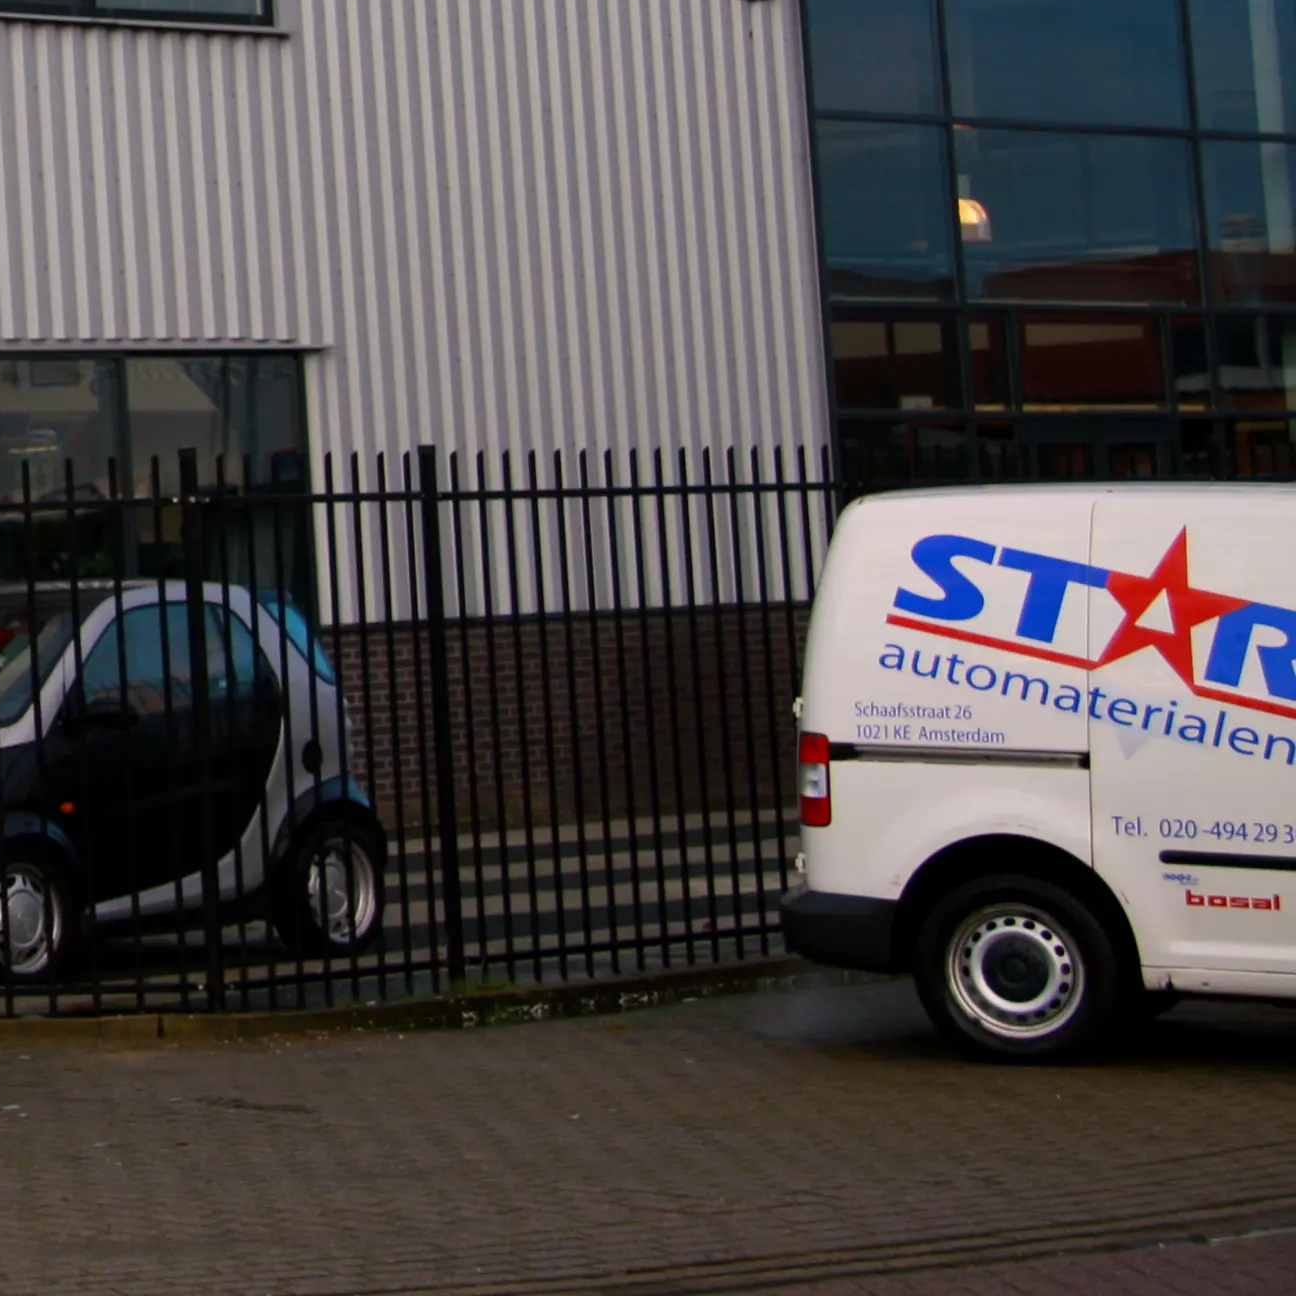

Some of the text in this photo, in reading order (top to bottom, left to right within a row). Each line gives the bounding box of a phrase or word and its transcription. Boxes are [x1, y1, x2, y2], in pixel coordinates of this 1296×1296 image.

[885, 525, 1296, 719] STAR
[854, 702, 972, 720] Schaafsstraat 26
[878, 640, 1296, 765] automaterialen
[856, 724, 1005, 743] 1021 KE Amsterdam
[1112, 816, 1148, 836] Tel.
[1253, 823, 1278, 842] 29
[1283, 824, 1296, 844] 3
[1185, 888, 1280, 911] bosal
